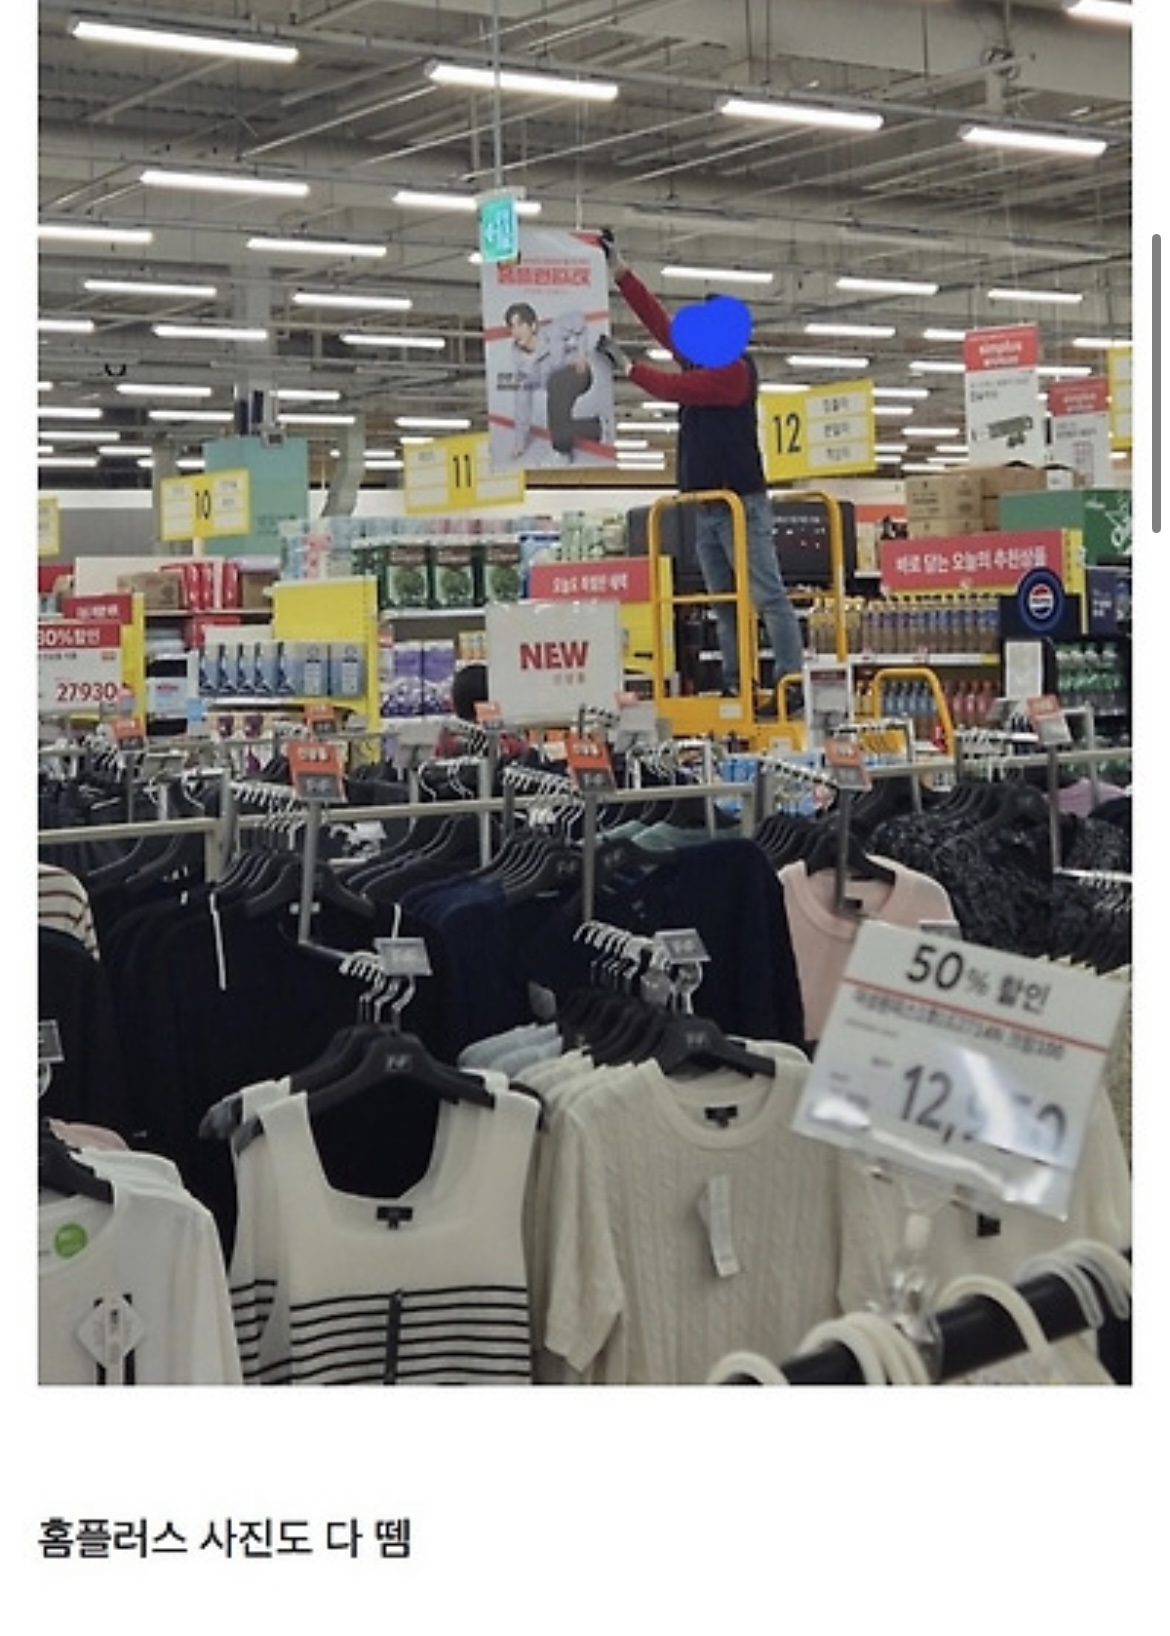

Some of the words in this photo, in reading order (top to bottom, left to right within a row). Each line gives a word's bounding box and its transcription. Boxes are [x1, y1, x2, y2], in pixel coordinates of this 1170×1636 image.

[773, 412, 801, 455] 12
[453, 454, 472, 488] 11
[195, 488, 212, 521] 10
[953, 549, 991, 573] 오늘의
[519, 640, 590, 671] NEW
[996, 973, 1053, 1016] 할인
